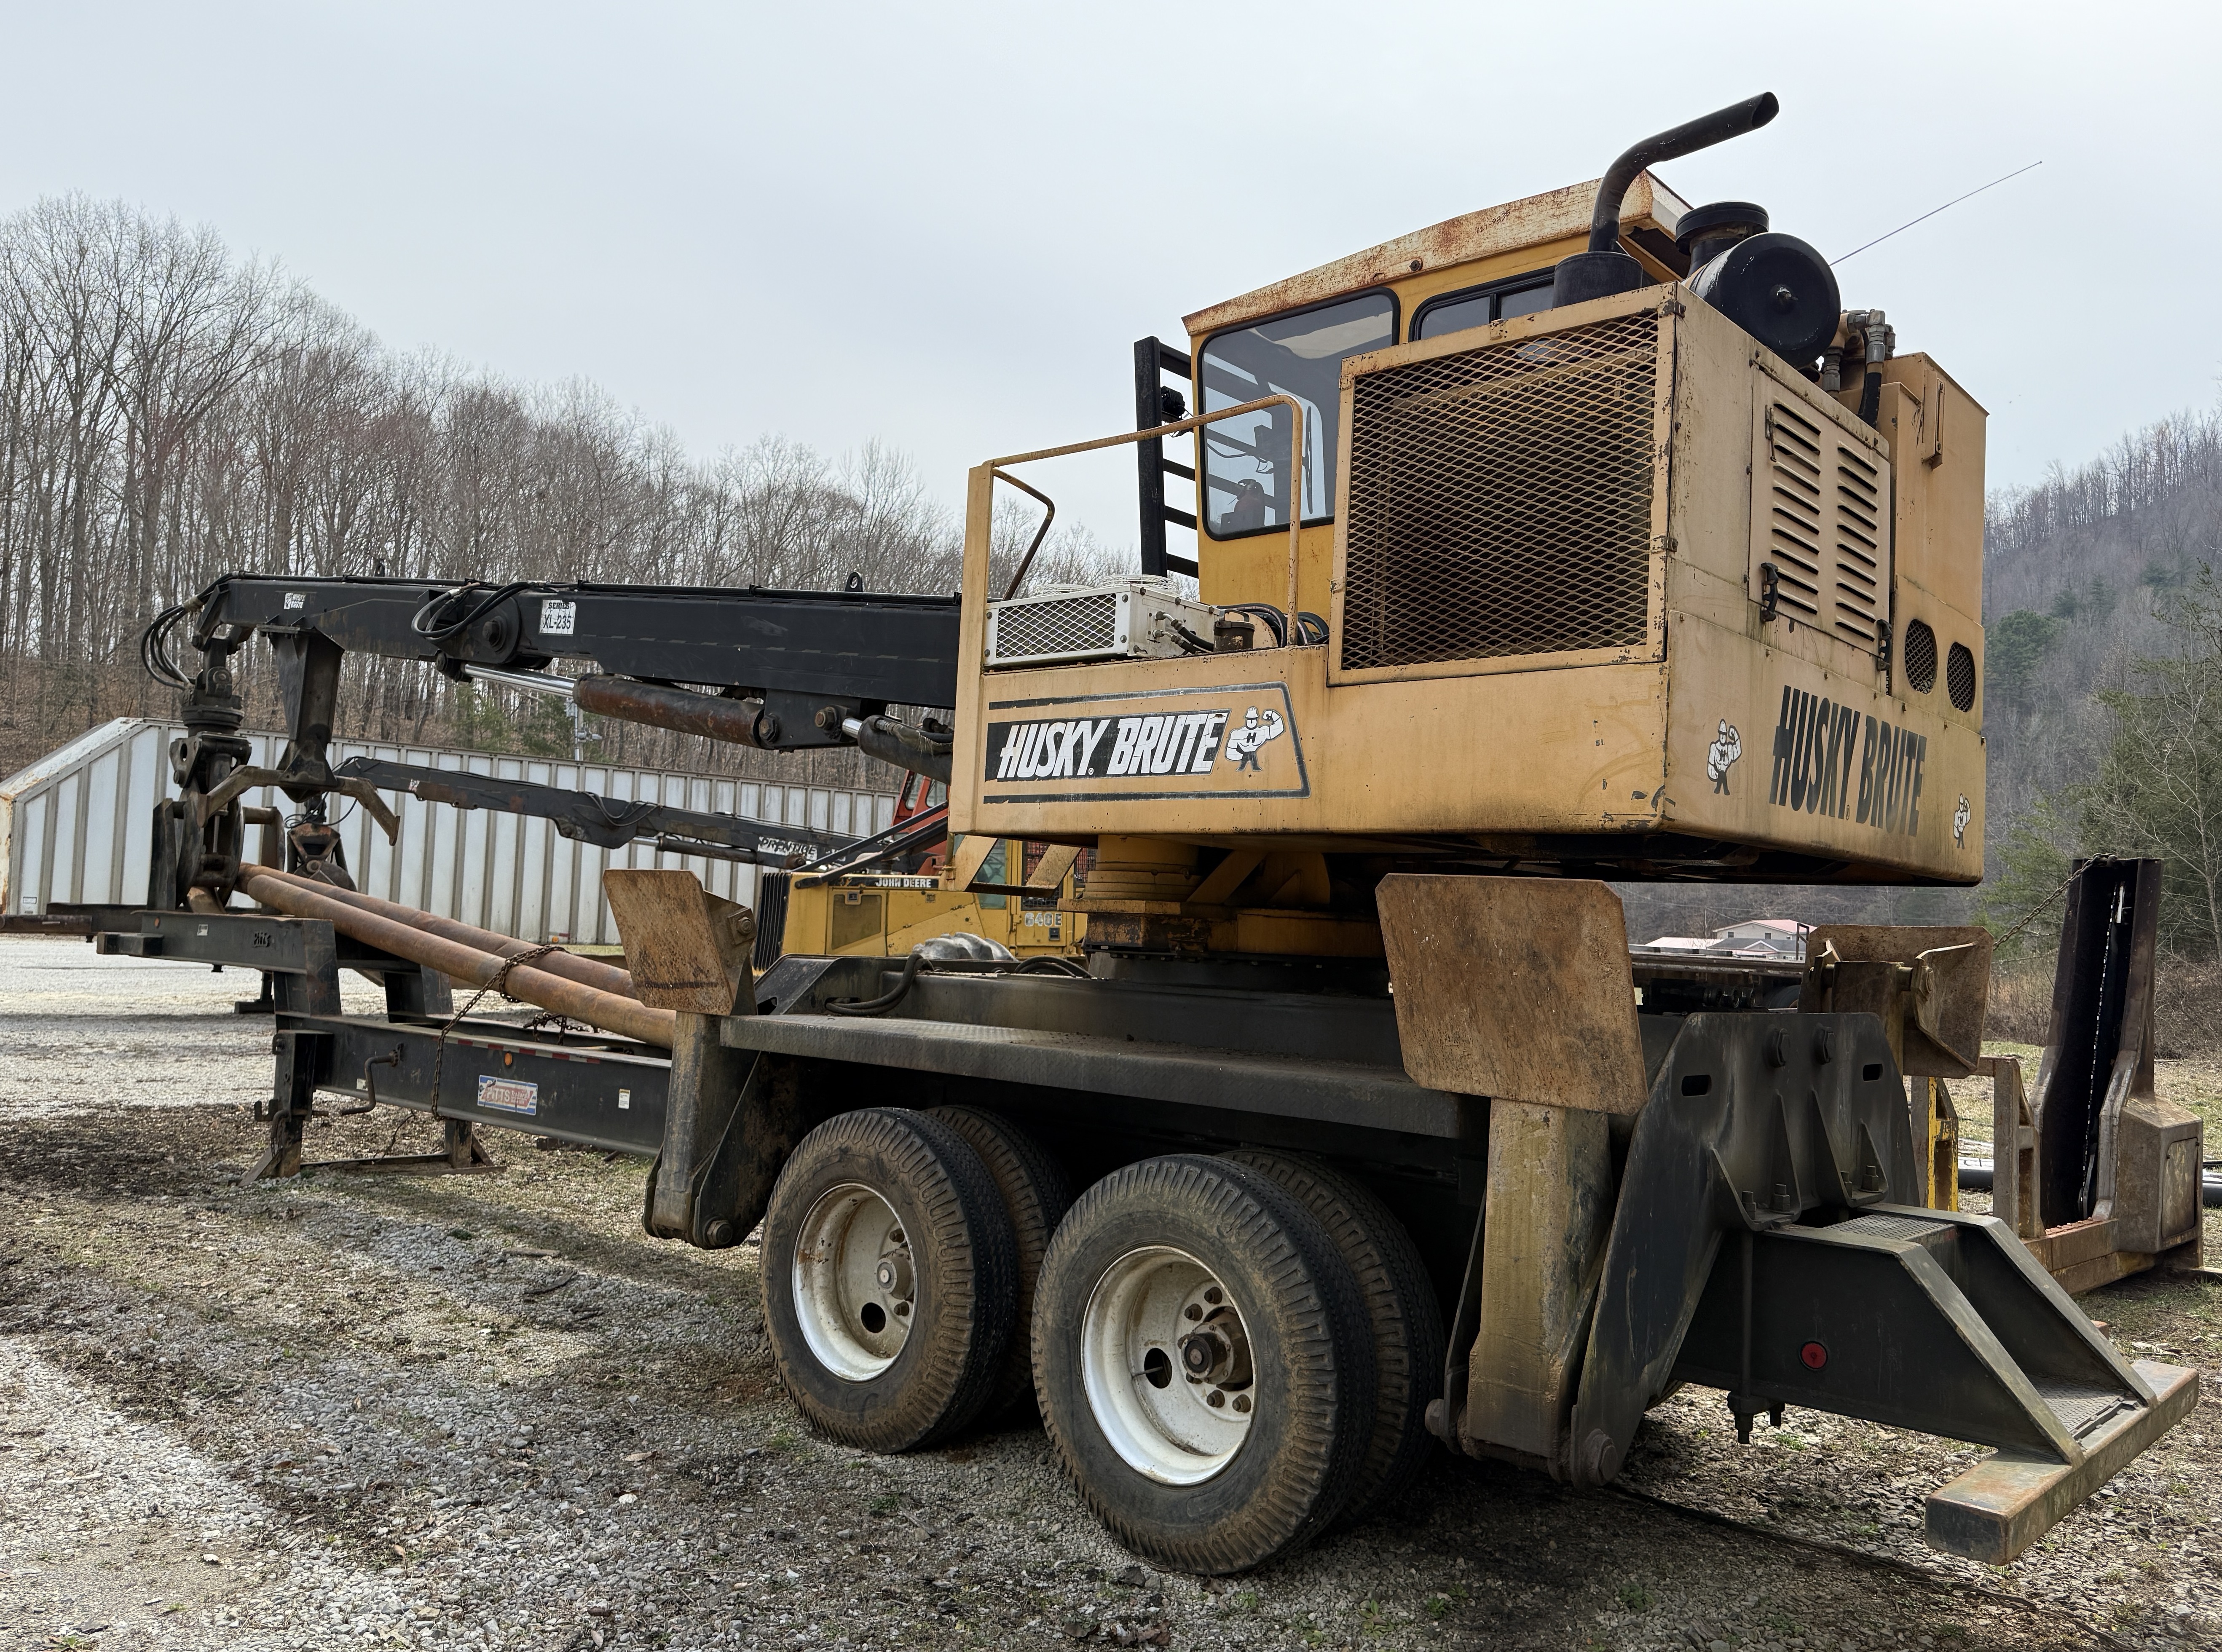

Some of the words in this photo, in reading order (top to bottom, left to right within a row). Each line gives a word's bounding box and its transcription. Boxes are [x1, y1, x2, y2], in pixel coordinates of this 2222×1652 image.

[543, 614, 571, 630] XL-235
[997, 719, 1111, 778] HUSKY
[1106, 712, 1227, 775] BRUTE
[1769, 685, 1860, 819] HUSKY
[1856, 715, 1927, 837] BRUTE
[876, 878, 901, 887] JOHN
[903, 879, 931, 888] DEERE
[1024, 912, 1062, 926] 640E
